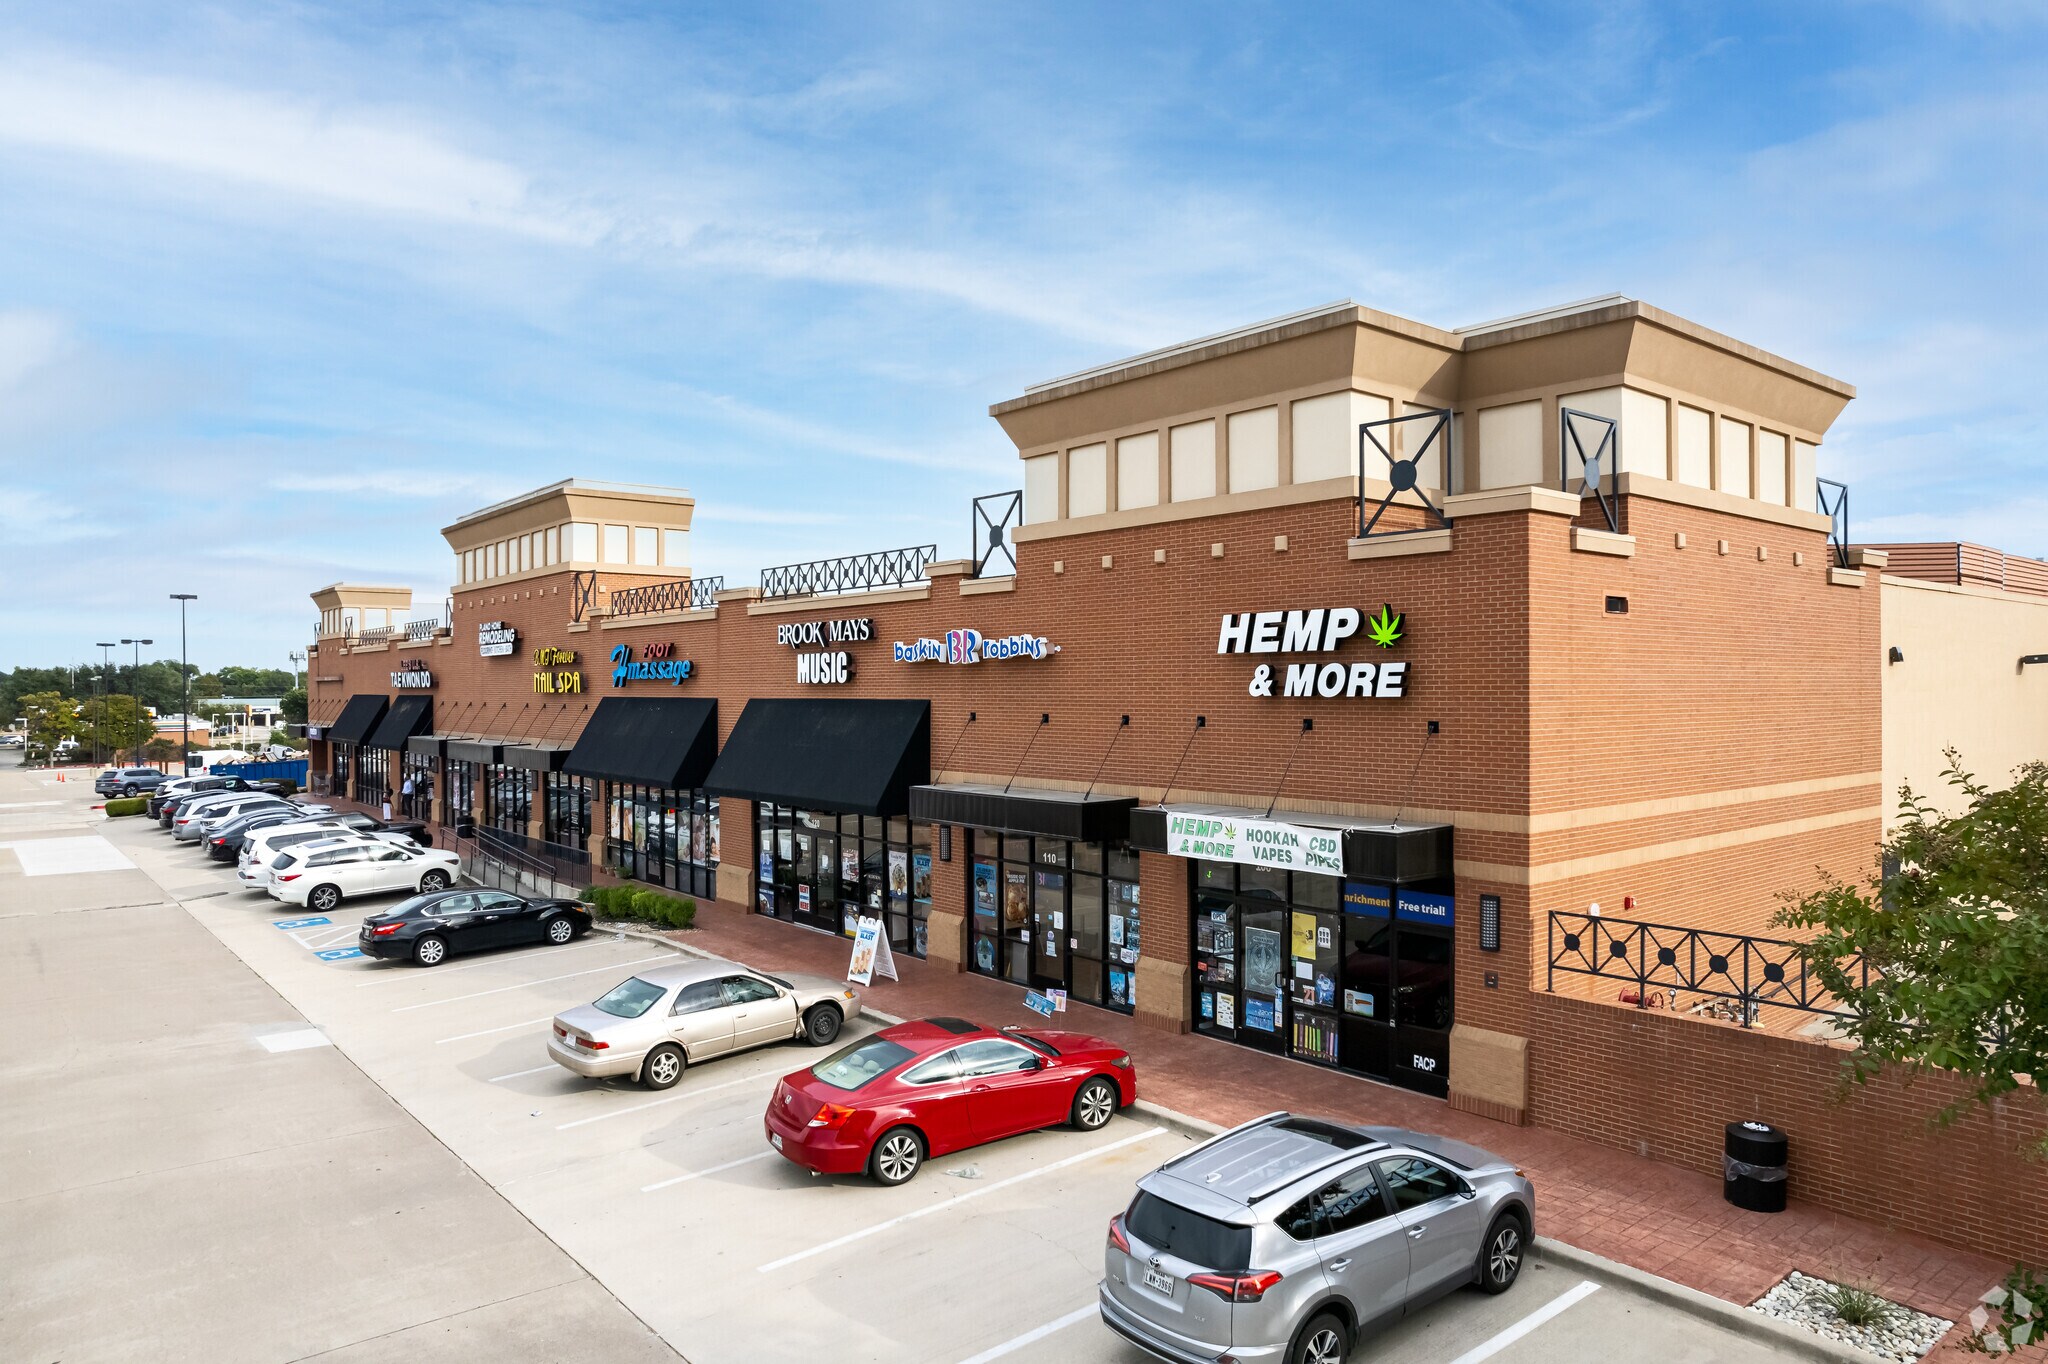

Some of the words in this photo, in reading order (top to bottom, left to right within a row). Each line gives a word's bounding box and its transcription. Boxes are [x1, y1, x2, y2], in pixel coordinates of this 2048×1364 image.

[478, 628, 515, 645] REMODELING
[777, 621, 825, 650] BROOK
[828, 618, 870, 642] MAYS
[1217, 607, 1360, 654] HEMP
[643, 643, 672, 658] FOOT
[894, 638, 941, 662] baskin
[946, 629, 977, 664] BR
[982, 635, 1041, 660] robbins
[797, 651, 848, 684] MUSIC
[390, 671, 401, 688] TAE
[401, 671, 420, 688] KWON
[420, 671, 431, 688] DO
[533, 671, 555, 693] NAIL
[558, 671, 581, 693] SPA
[1248, 664, 1273, 698] &
[1283, 662, 1406, 698] MORE
[1170, 816, 1223, 838] HEMP
[1179, 838, 1189, 853] &
[1193, 840, 1235, 859] MORE
[1246, 828, 1300, 847] HOOKAH
[1308, 836, 1337, 853] CBD
[1043, 852, 1057, 864] 110
[1252, 846, 1293, 864] VAPES
[1305, 852, 1341, 870] PIPES
[1212, 912, 1227, 921] OPEN
[1398, 900, 1420, 912] Free
[1421, 904, 1446, 916] trial!
[1303, 988, 1315, 1004] 21
[1413, 1054, 1436, 1071] FACP
